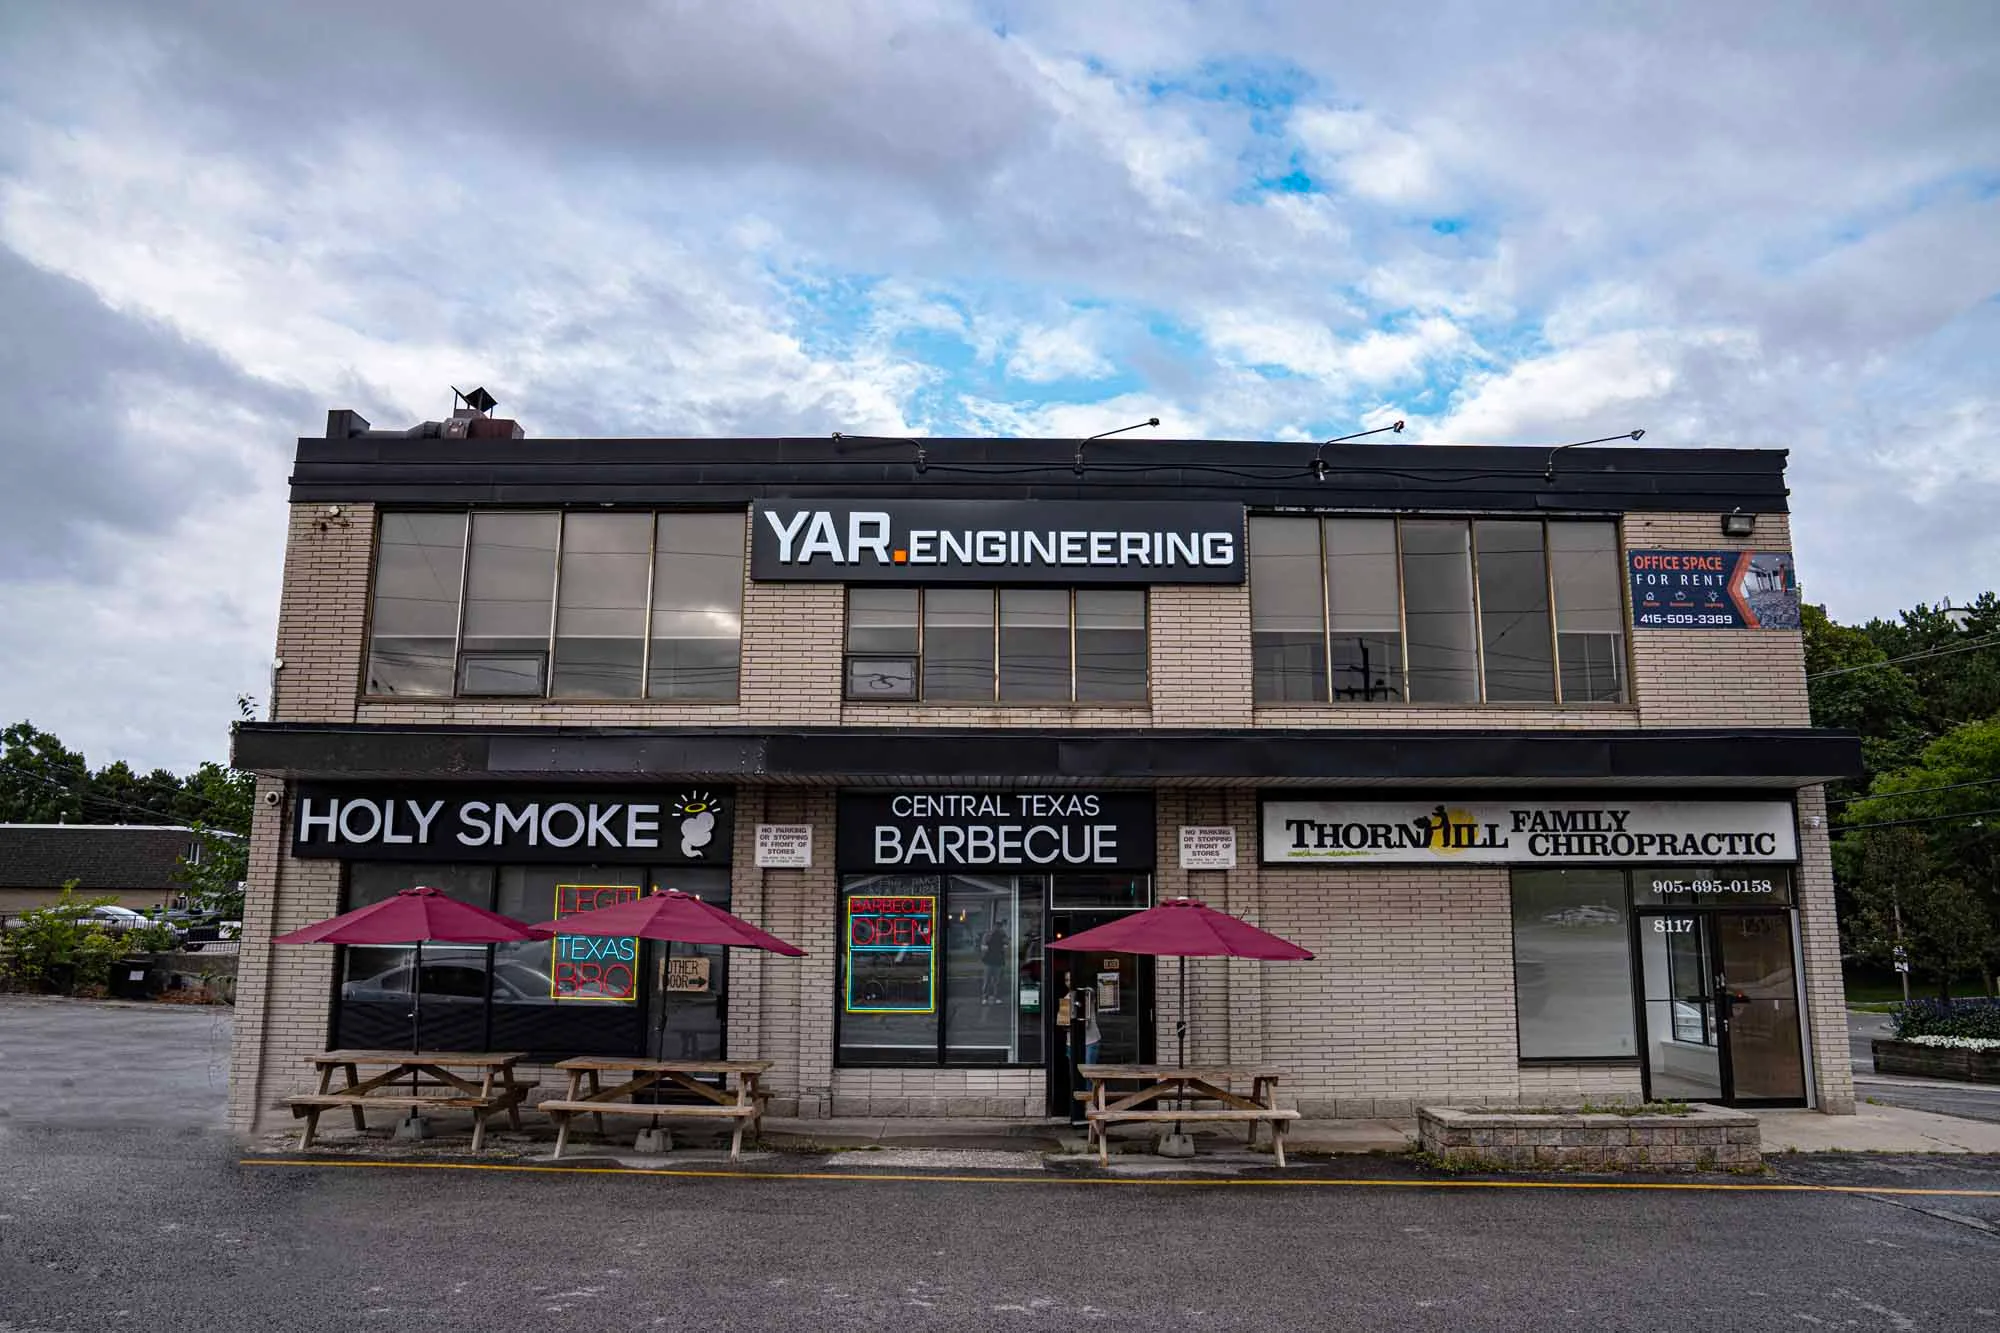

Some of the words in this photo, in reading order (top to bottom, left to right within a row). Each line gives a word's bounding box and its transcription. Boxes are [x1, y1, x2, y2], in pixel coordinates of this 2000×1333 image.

[1633, 556, 1680, 570] OFFICE
[1682, 557, 1723, 571] SPACE
[1636, 574, 1669, 585] FOR
[1680, 574, 1725, 586] RENT
[1640, 614, 1733, 624] 416-509-3389
[892, 795, 1010, 817] CENTRAL
[1016, 795, 1100, 817] TEXAS
[300, 799, 445, 844] HOLY
[456, 801, 659, 847] SMOKE
[1510, 810, 1631, 833] FAMILY
[875, 825, 1118, 864] BARBECUE
[1528, 832, 1776, 857] CHIROPRACTIC
[1652, 880, 1772, 893] 905-695-0158
[852, 918, 931, 945] OPEN
[1653, 920, 1694, 933] 8117
[557, 936, 635, 960] TEXAS
[555, 962, 633, 997] BBQ
[664, 975, 688, 988] OOR
